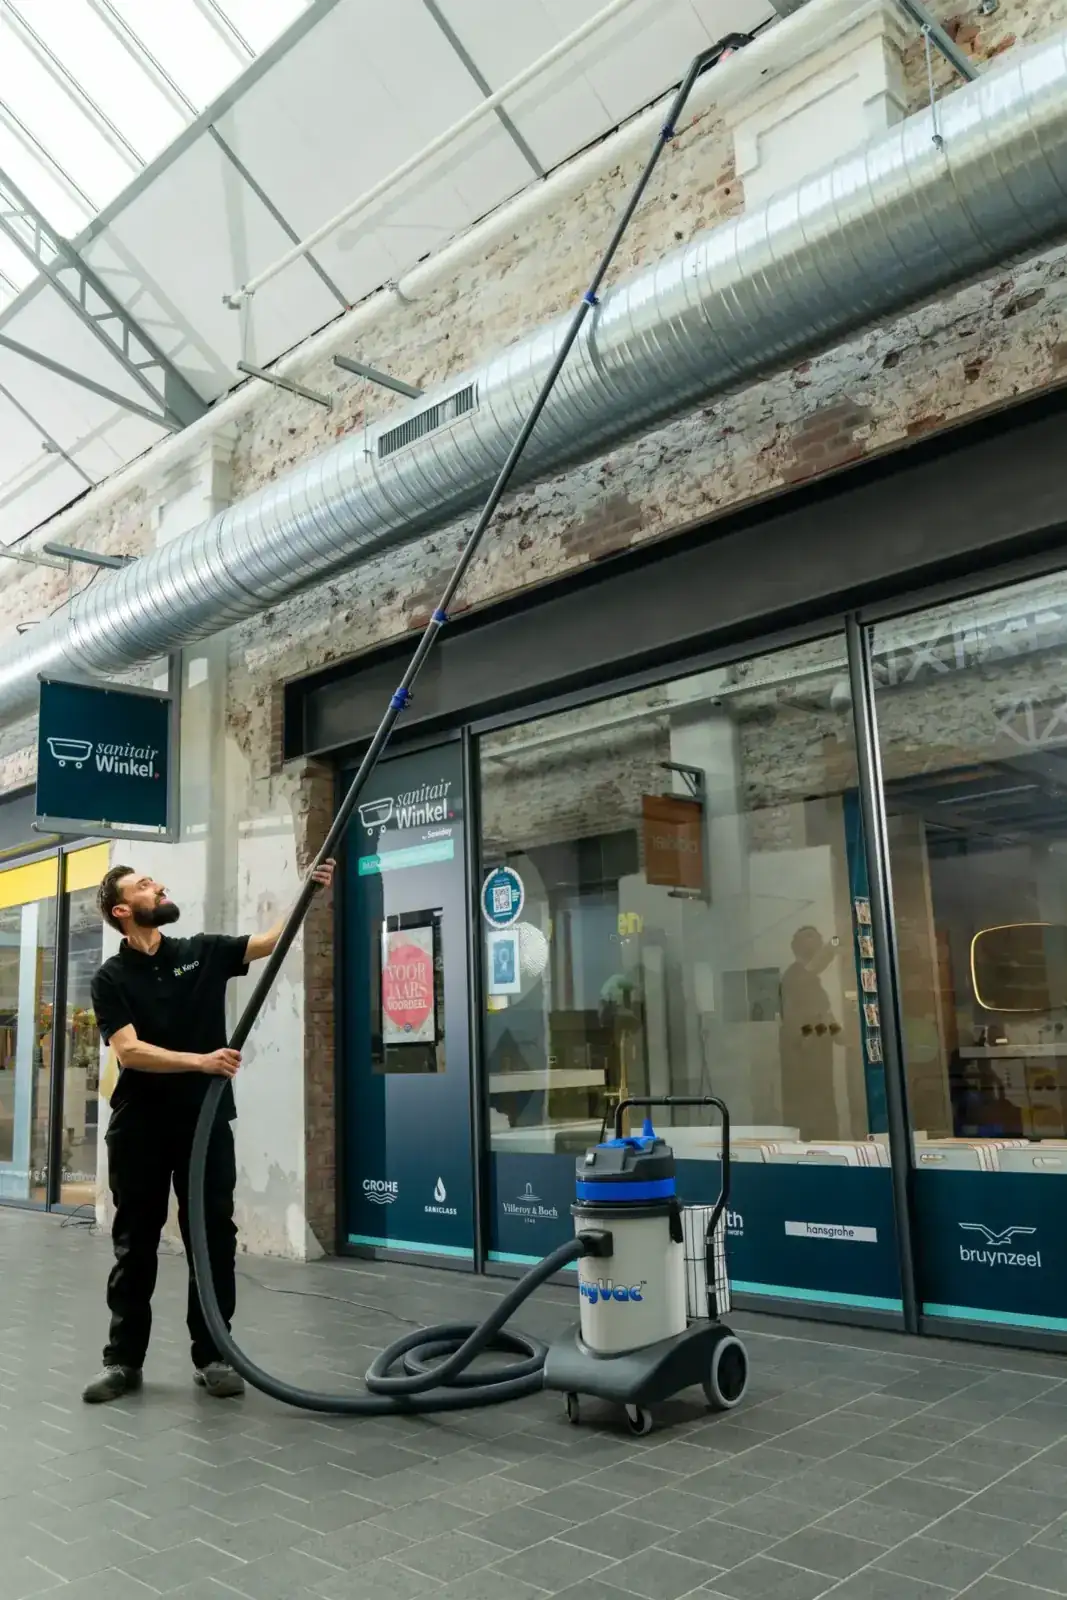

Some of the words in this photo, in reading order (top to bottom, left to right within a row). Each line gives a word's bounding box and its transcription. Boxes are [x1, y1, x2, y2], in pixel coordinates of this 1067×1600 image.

[96, 742, 159, 760] sanitair
[396, 778, 452, 808] sanitair
[386, 962, 426, 981] VOOR
[387, 981, 428, 1001] JAARS
[386, 999, 429, 1011] VOORDEEL
[363, 1179, 399, 1193] GROHE
[424, 1205, 458, 1215] SANICLASS
[502, 1202, 531, 1215] Villeroy
[531, 1205, 538, 1215] &
[538, 1205, 559, 1217] Boch
[806, 1222, 855, 1238] hansgrohe
[960, 1244, 1042, 1268] bruynzeel
